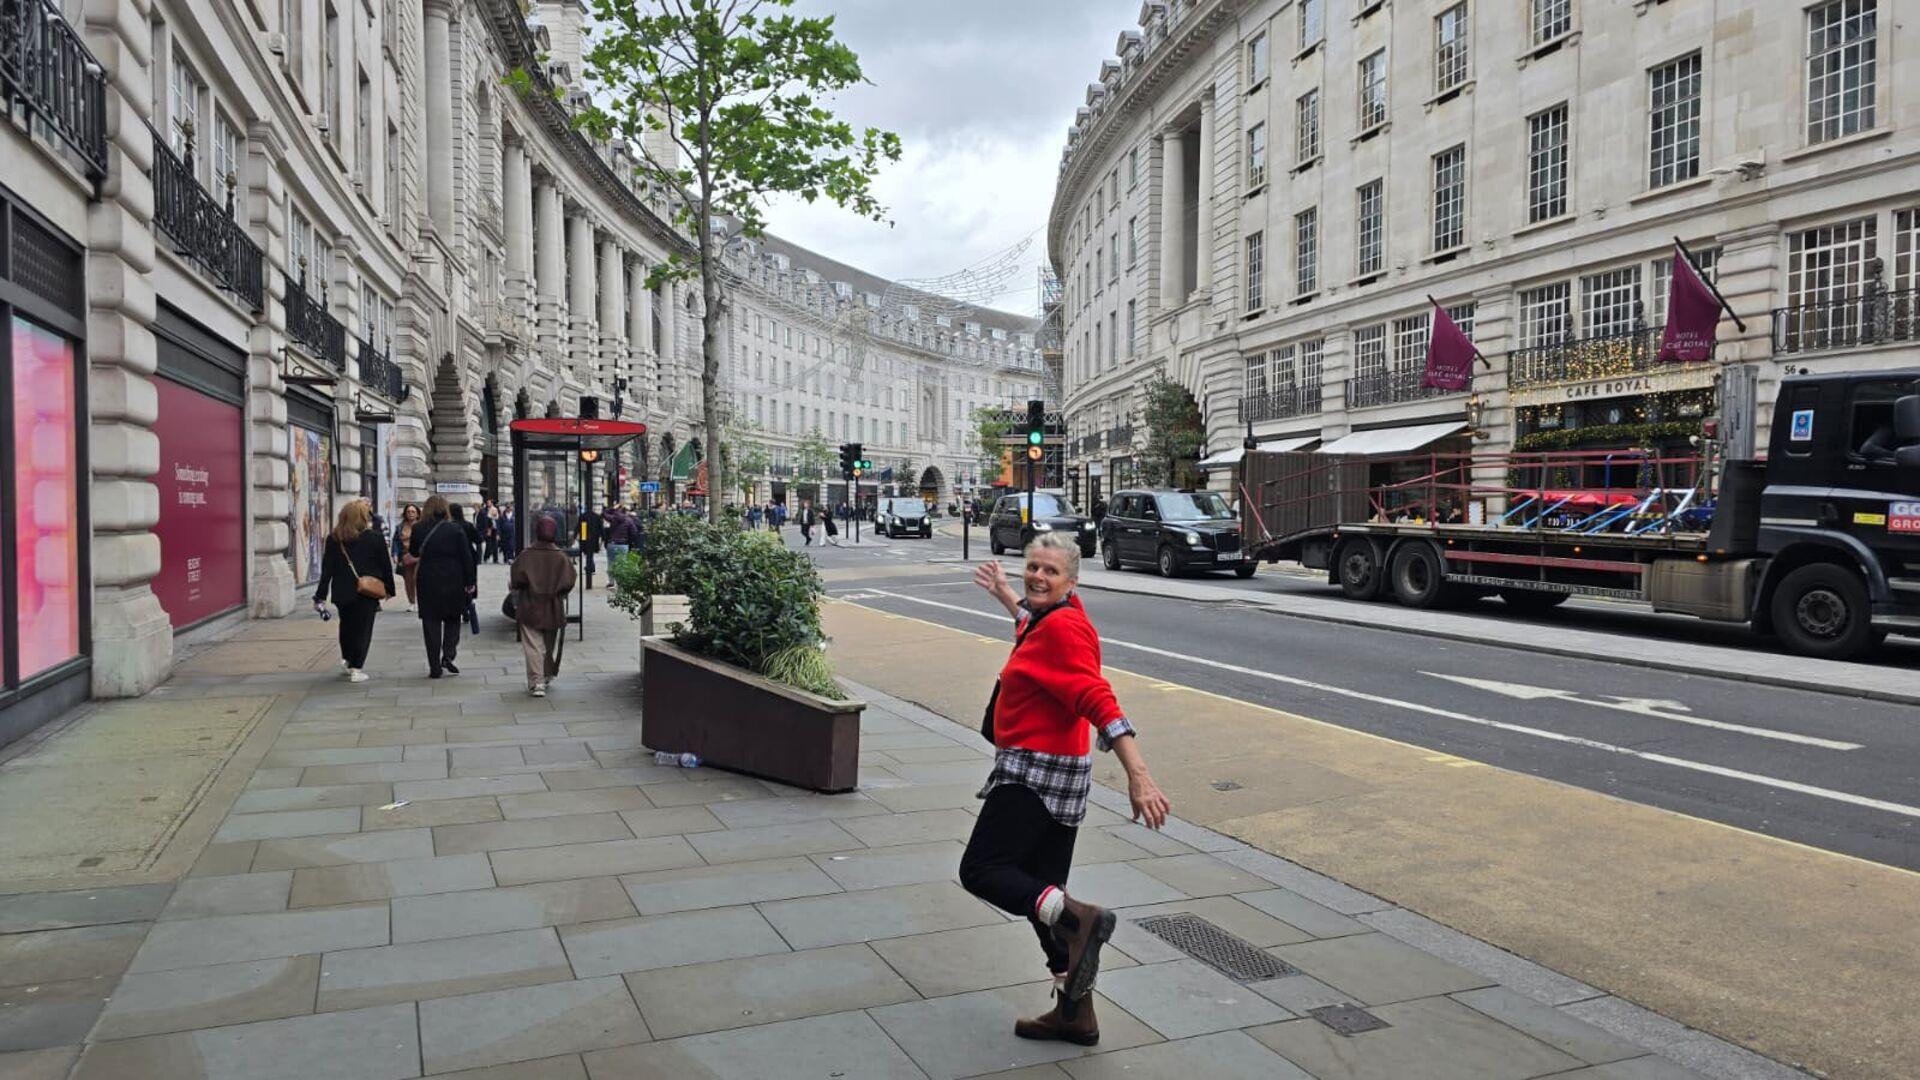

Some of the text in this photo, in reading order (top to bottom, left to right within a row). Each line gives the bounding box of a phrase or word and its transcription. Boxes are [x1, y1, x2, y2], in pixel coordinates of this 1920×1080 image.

[1784, 364, 1796, 375] 56
[1566, 379, 1651, 398] CAFE ROYAL
